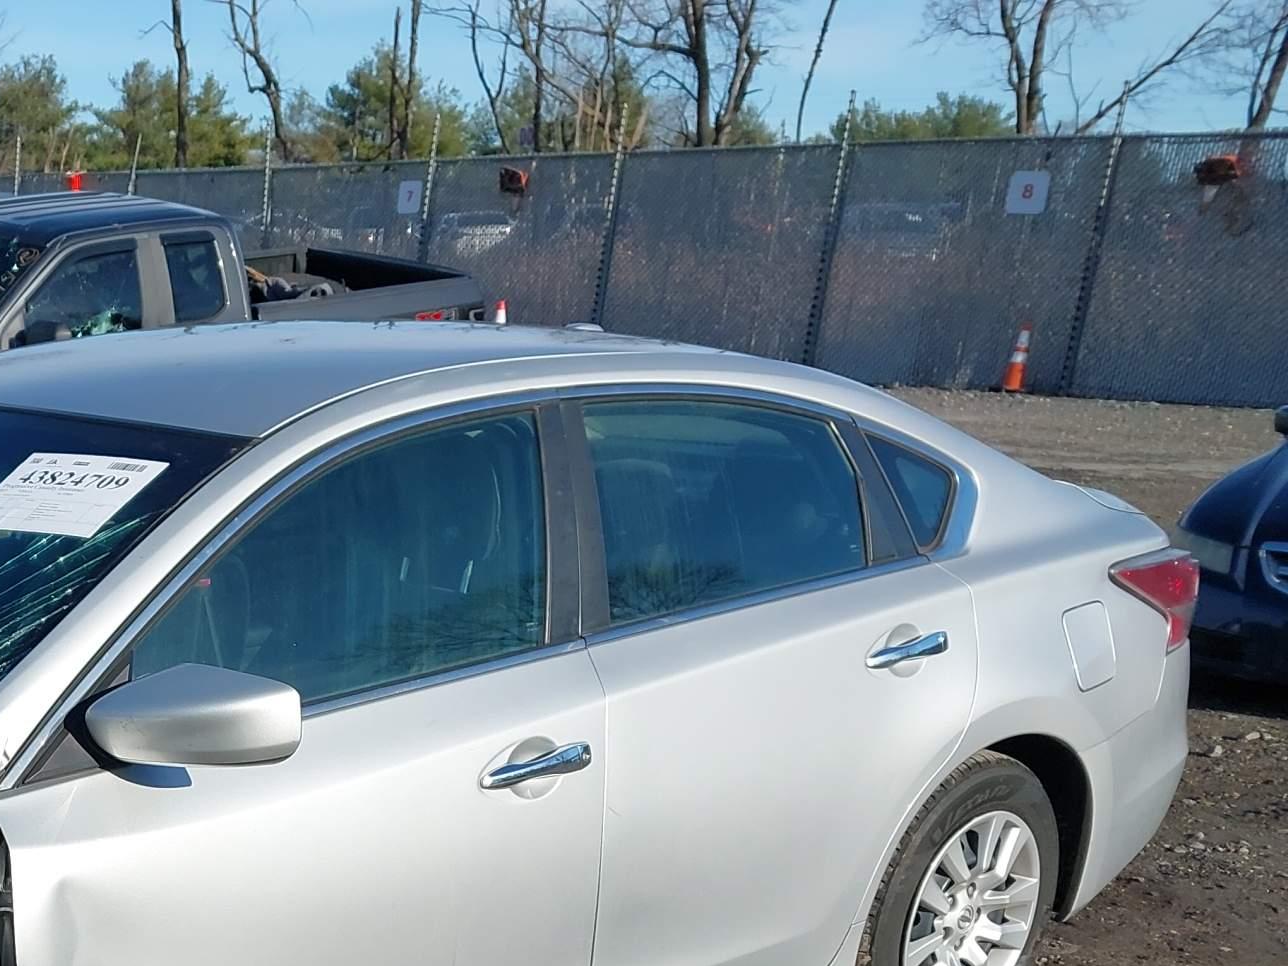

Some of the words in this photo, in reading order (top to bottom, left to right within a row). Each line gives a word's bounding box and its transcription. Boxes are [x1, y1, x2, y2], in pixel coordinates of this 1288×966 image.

[407, 190, 414, 202] 7
[1022, 183, 1034, 199] 8
[19, 469, 131, 491] 43824709
